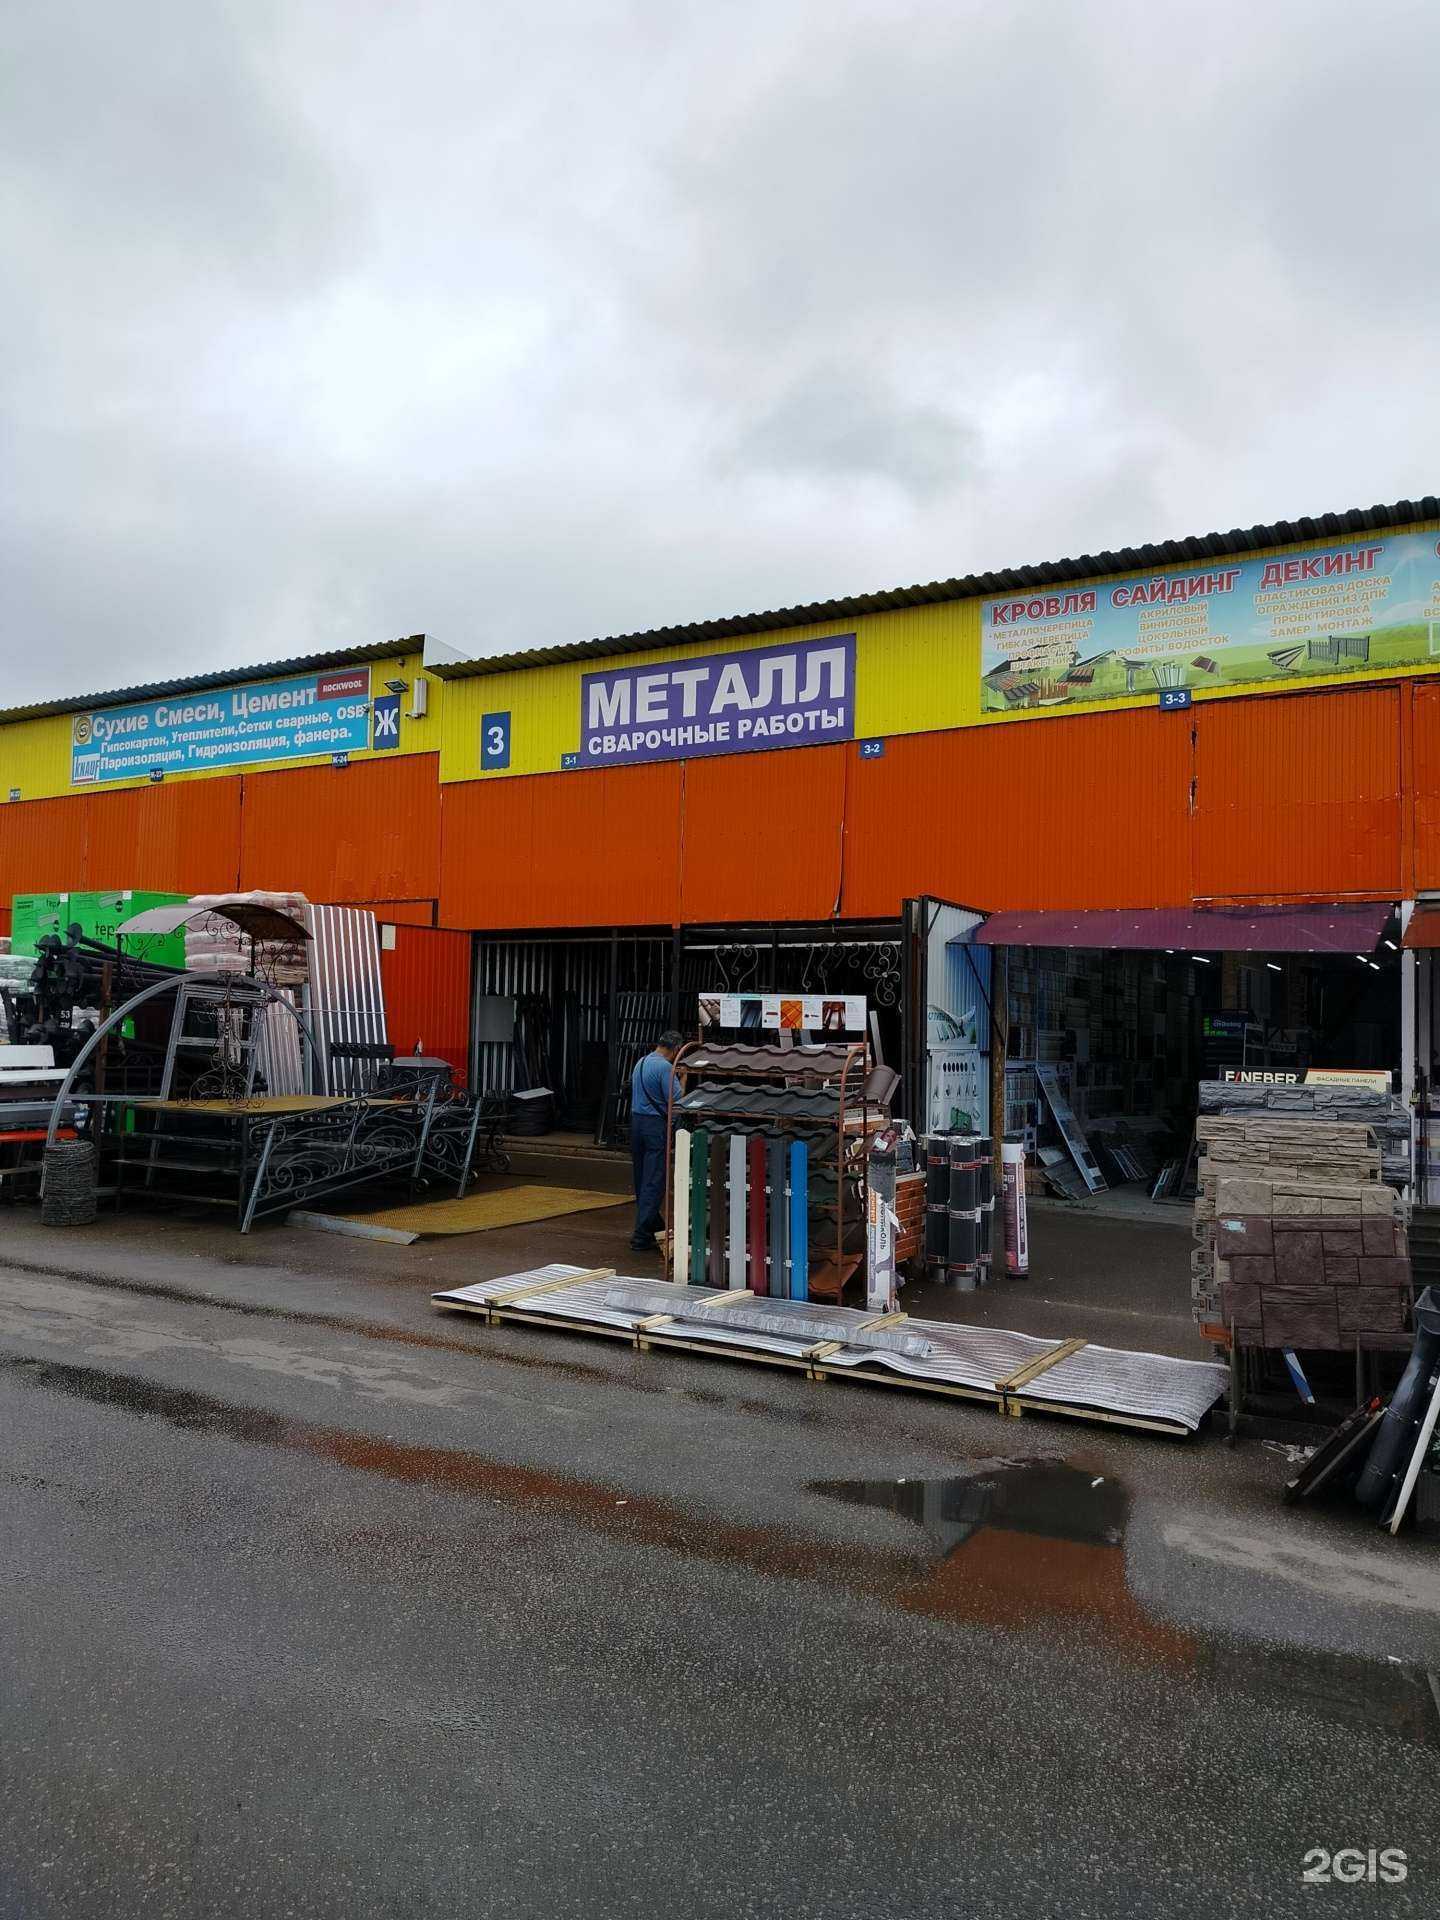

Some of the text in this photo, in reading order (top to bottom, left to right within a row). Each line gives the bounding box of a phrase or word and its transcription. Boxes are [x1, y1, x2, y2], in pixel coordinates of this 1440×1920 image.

[1260, 547, 1384, 590] ДЕКИНГ
[1111, 569, 1241, 607] САЙДИНГ
[1255, 575, 1391, 603] ПЛАСТИКОВАЯ ДОСКА
[992, 591, 1097, 626] КРОВЛЯ
[1140, 602, 1207, 619] АКРИЛОВЫЙ
[1257, 596, 1340, 615] ОГРАЖДЕНИЯ
[1343, 594, 1357, 603] ИЗ
[1273, 605, 1370, 625] ПРОЕКТИРОВКА
[993, 619, 1093, 640] МЕТАЛЛОЧЕРЕПИЦА
[1138, 626, 1208, 644] ЦОКОЛЬНЫЙ
[1140, 615, 1207, 631] ВИНИЛОВЫЙ
[1270, 617, 1373, 638] ЗАМЕР МОНТАЖ
[1168, 634, 1229, 651] ВОДОСТОК
[323, 679, 363, 692] ROCKWOOL
[588, 647, 846, 730] МЕТАЛЛ
[93, 714, 148, 740] Сухие
[155, 703, 225, 728] Смеси,
[232, 688, 316, 718] Цемент
[374, 708, 399, 736] Ж
[101, 736, 168, 753] Гипсокартон,
[276, 711, 333, 729] сварные,
[588, 707, 845, 755] СВАРОЧНЫЕ РАБОТЫ
[101, 727, 352, 771] Пароизоляция, Гидроизоляция, фанера.
